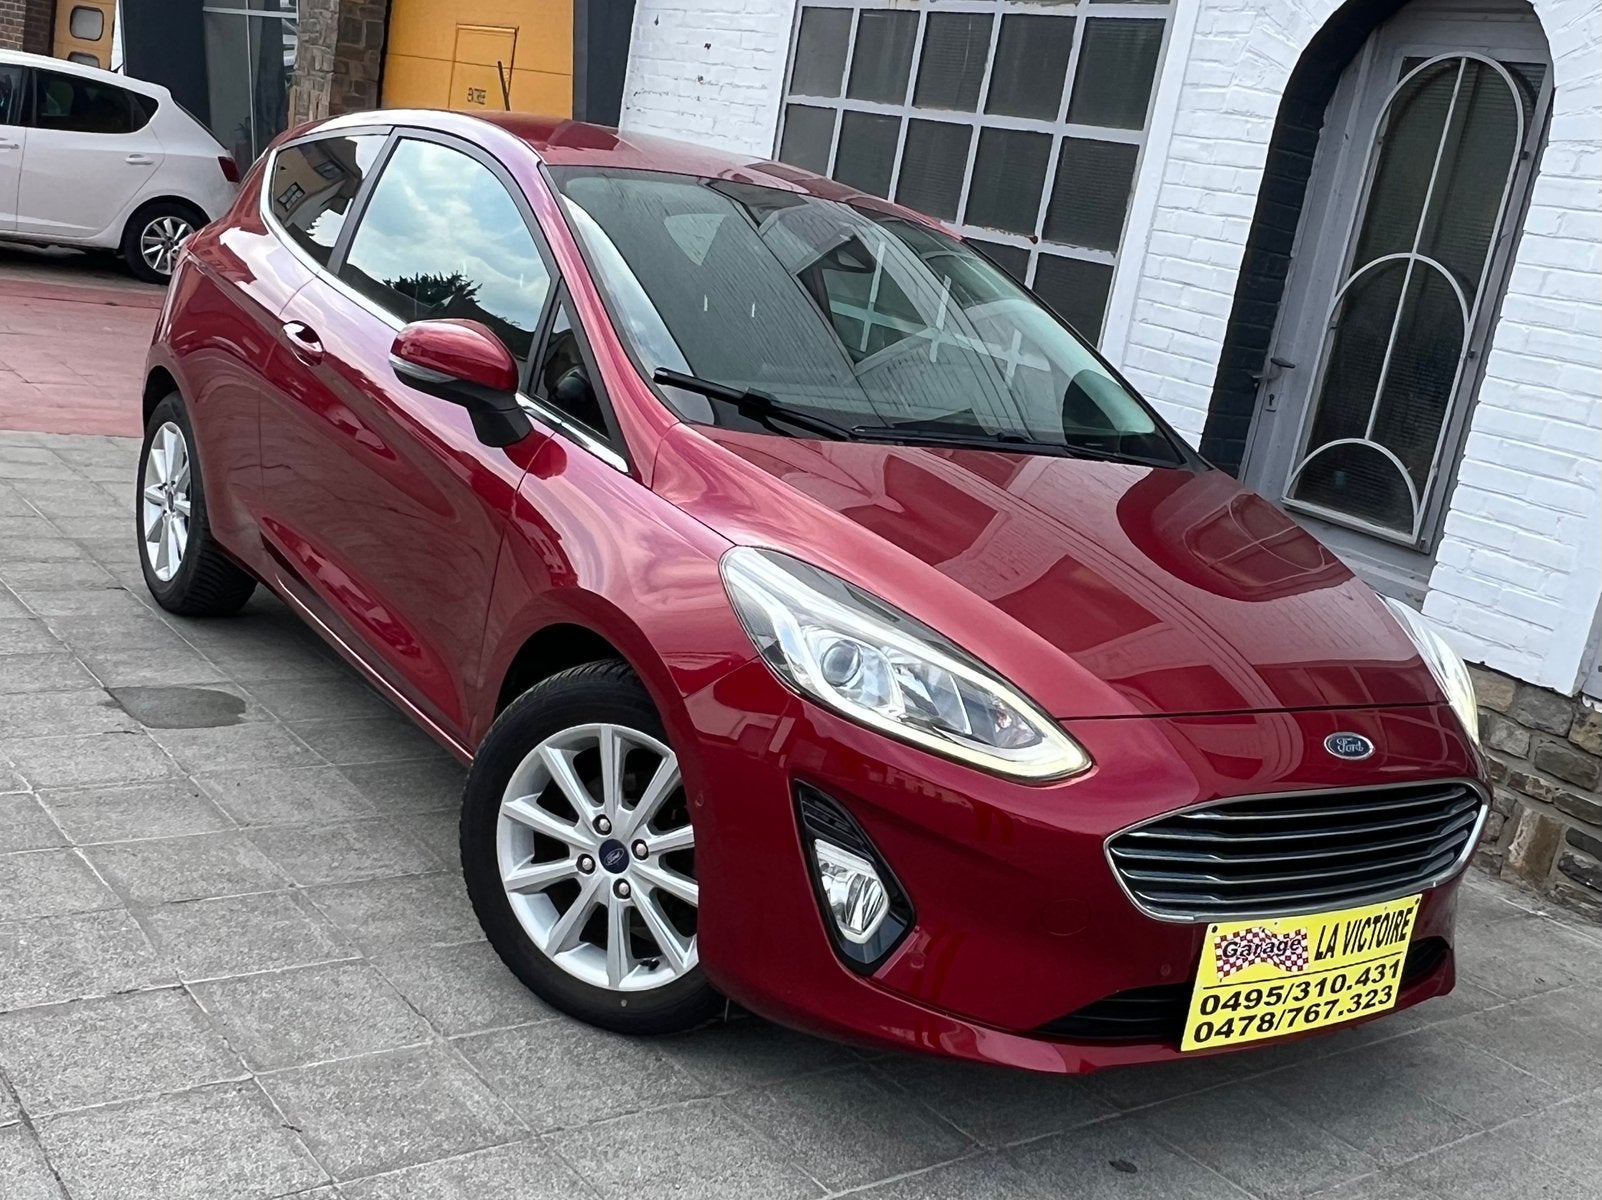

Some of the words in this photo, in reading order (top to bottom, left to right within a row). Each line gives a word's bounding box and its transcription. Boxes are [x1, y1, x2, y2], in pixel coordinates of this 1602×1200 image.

[1336, 738, 1364, 753] Ford
[1222, 937, 1302, 961] Garage
[1314, 923, 1340, 961] LA
[1342, 906, 1414, 956] VICTOIRE
[1193, 985, 1393, 1043] 0478/767.323
[1200, 958, 1401, 1016] 0495/310.431
